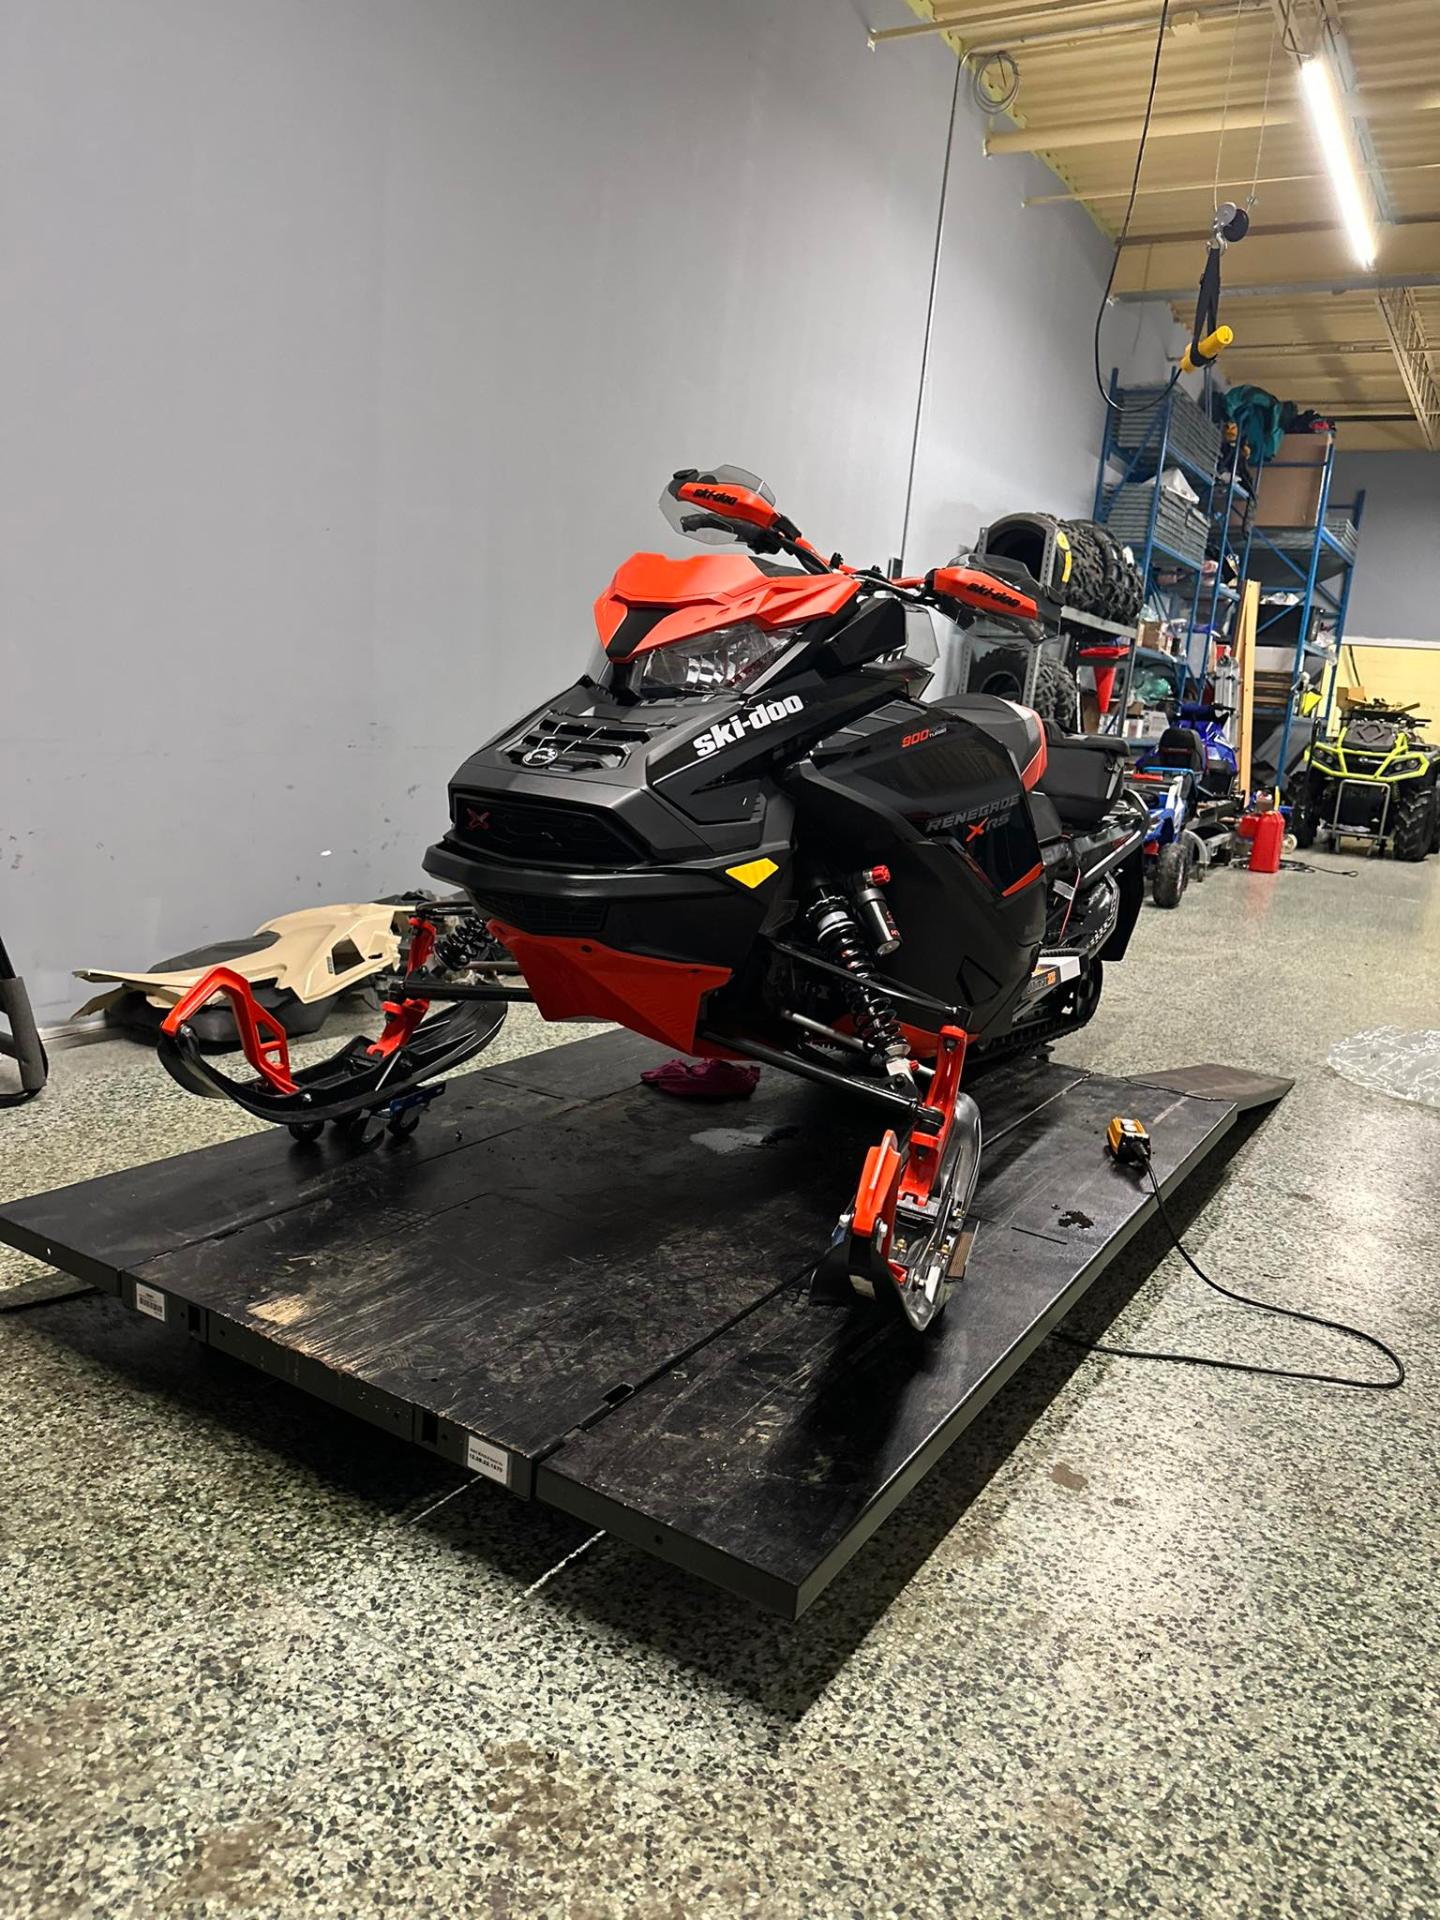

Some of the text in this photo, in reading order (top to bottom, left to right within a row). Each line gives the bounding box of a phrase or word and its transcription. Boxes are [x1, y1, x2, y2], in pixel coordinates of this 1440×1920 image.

[693, 488, 738, 506] ski-doo
[966, 582, 1021, 607] ski-doo
[693, 695, 804, 757] ski-doo
[902, 729, 929, 748] 900
[926, 793, 1020, 832] RENEGADE
